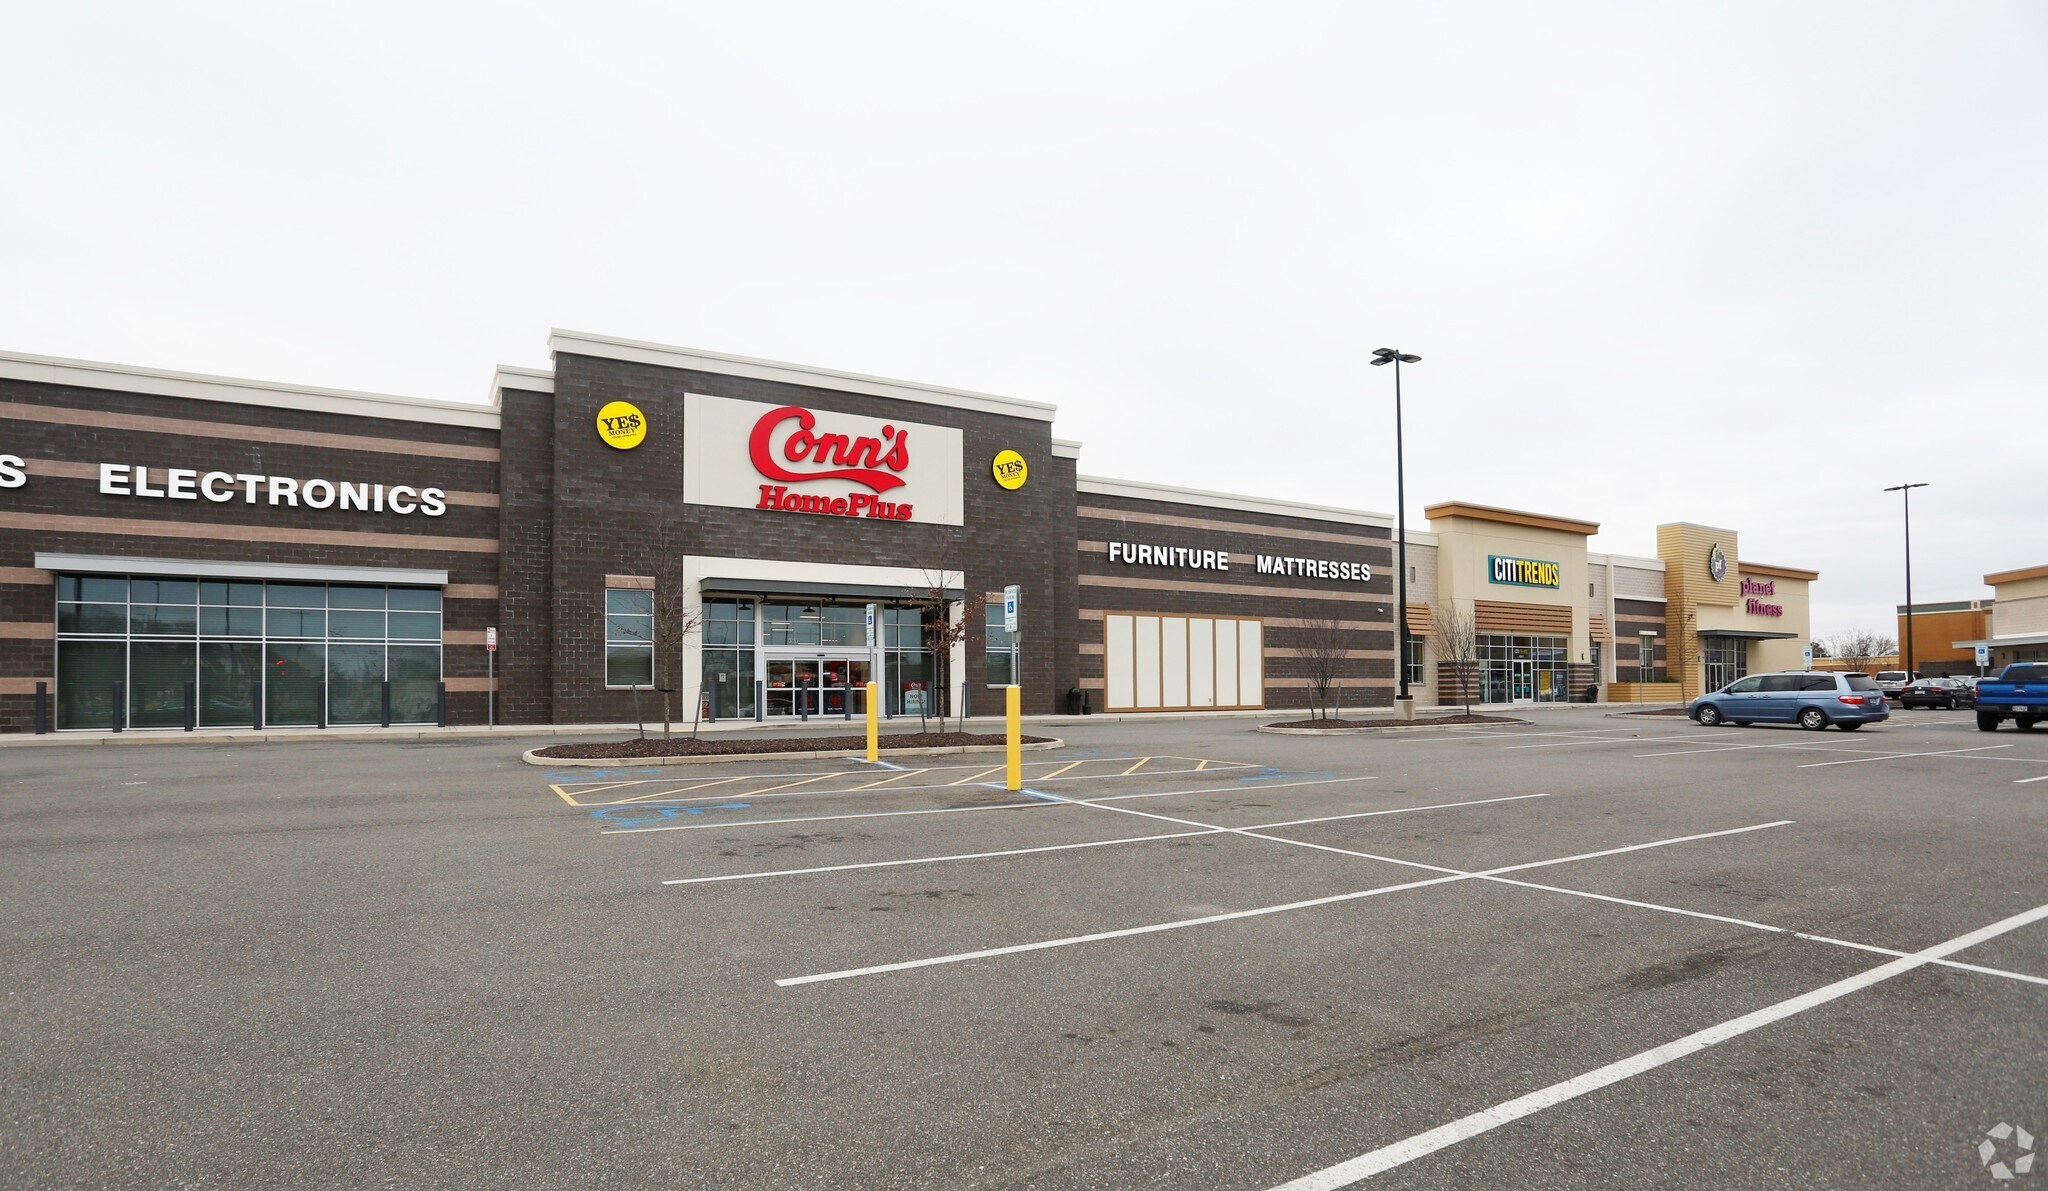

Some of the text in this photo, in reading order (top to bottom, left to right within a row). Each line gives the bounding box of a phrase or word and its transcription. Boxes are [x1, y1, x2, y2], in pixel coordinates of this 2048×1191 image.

[601, 413, 641, 430] YE$
[609, 428, 636, 436] MONEY
[749, 406, 909, 493] Conn's
[100, 463, 447, 516] ELECTRONICS
[756, 485, 913, 520] HomePlus
[1108, 541, 1371, 581] FURNITURE MATTRESSES
[1740, 578, 1776, 598] planet
[1746, 599, 1783, 617] fitness
